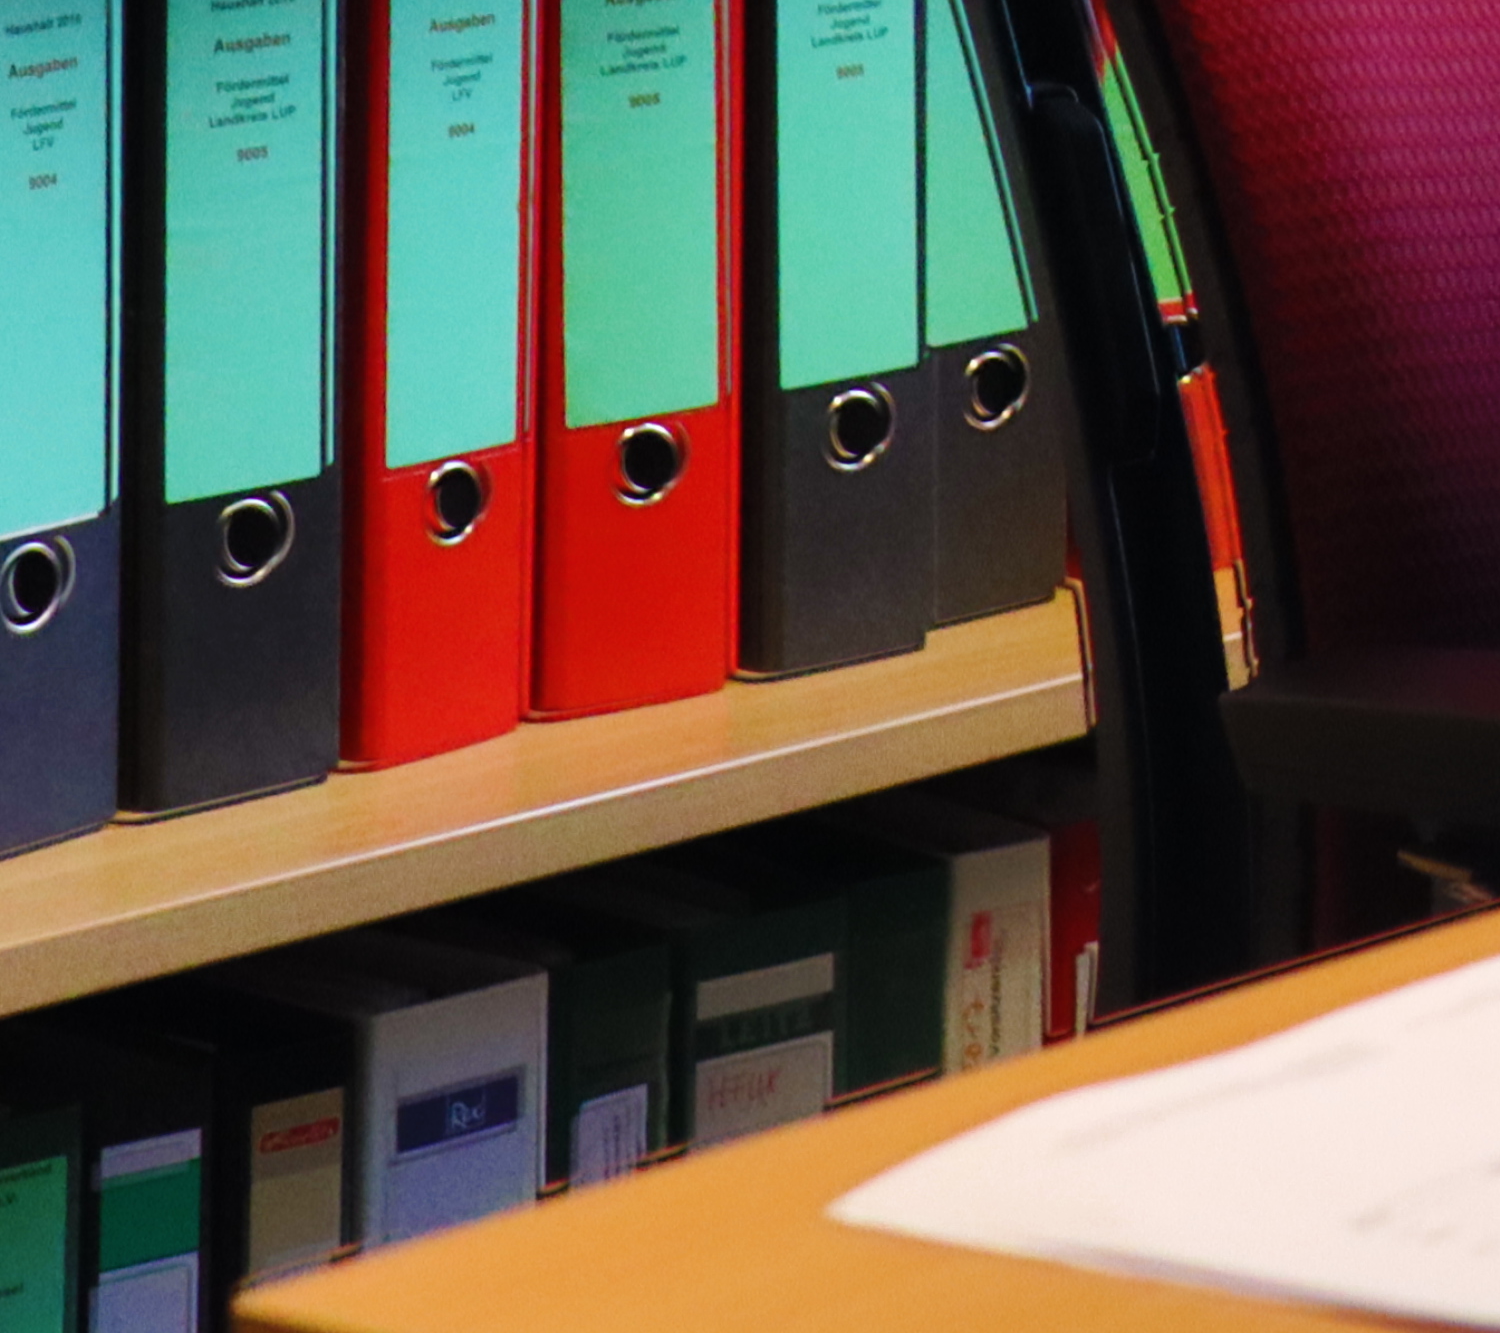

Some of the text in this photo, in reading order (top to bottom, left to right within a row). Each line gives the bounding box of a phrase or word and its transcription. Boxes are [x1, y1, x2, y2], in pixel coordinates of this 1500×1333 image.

[429, 12, 496, 34] Ausgaben
[214, 32, 291, 54] Ausgaben
[8, 56, 79, 80] Ausgaben
